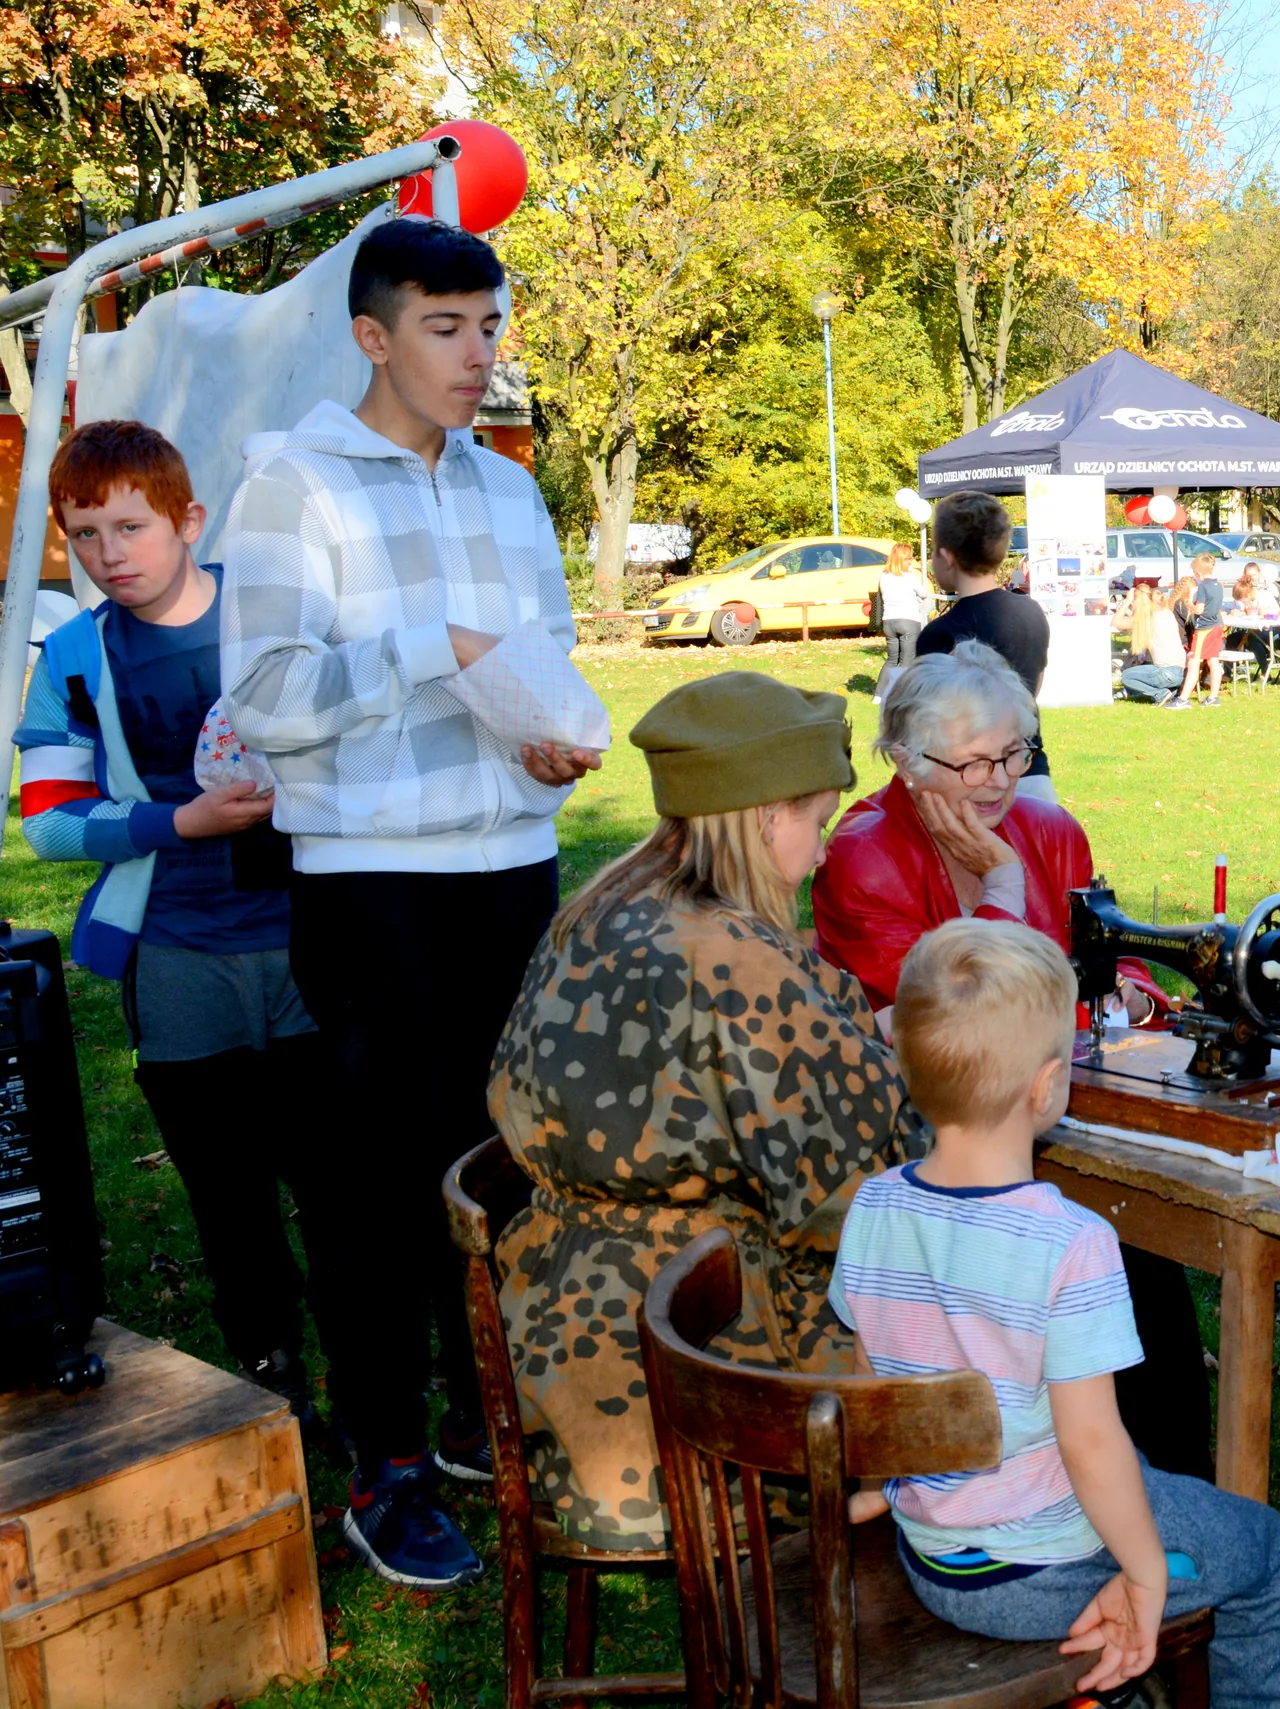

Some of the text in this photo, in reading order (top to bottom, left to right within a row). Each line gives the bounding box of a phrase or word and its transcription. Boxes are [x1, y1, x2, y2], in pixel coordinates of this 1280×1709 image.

[924, 473, 943, 485] URZĄD
[943, 470, 972, 483] DZIELNICY
[972, 467, 997, 479] OCHOTA
[1074, 461, 1115, 476] URZĄD
[1117, 460, 1176, 473] DZIELNICY
[1177, 460, 1227, 473] OCHOTA
[1228, 461, 1256, 473] M.ST.
